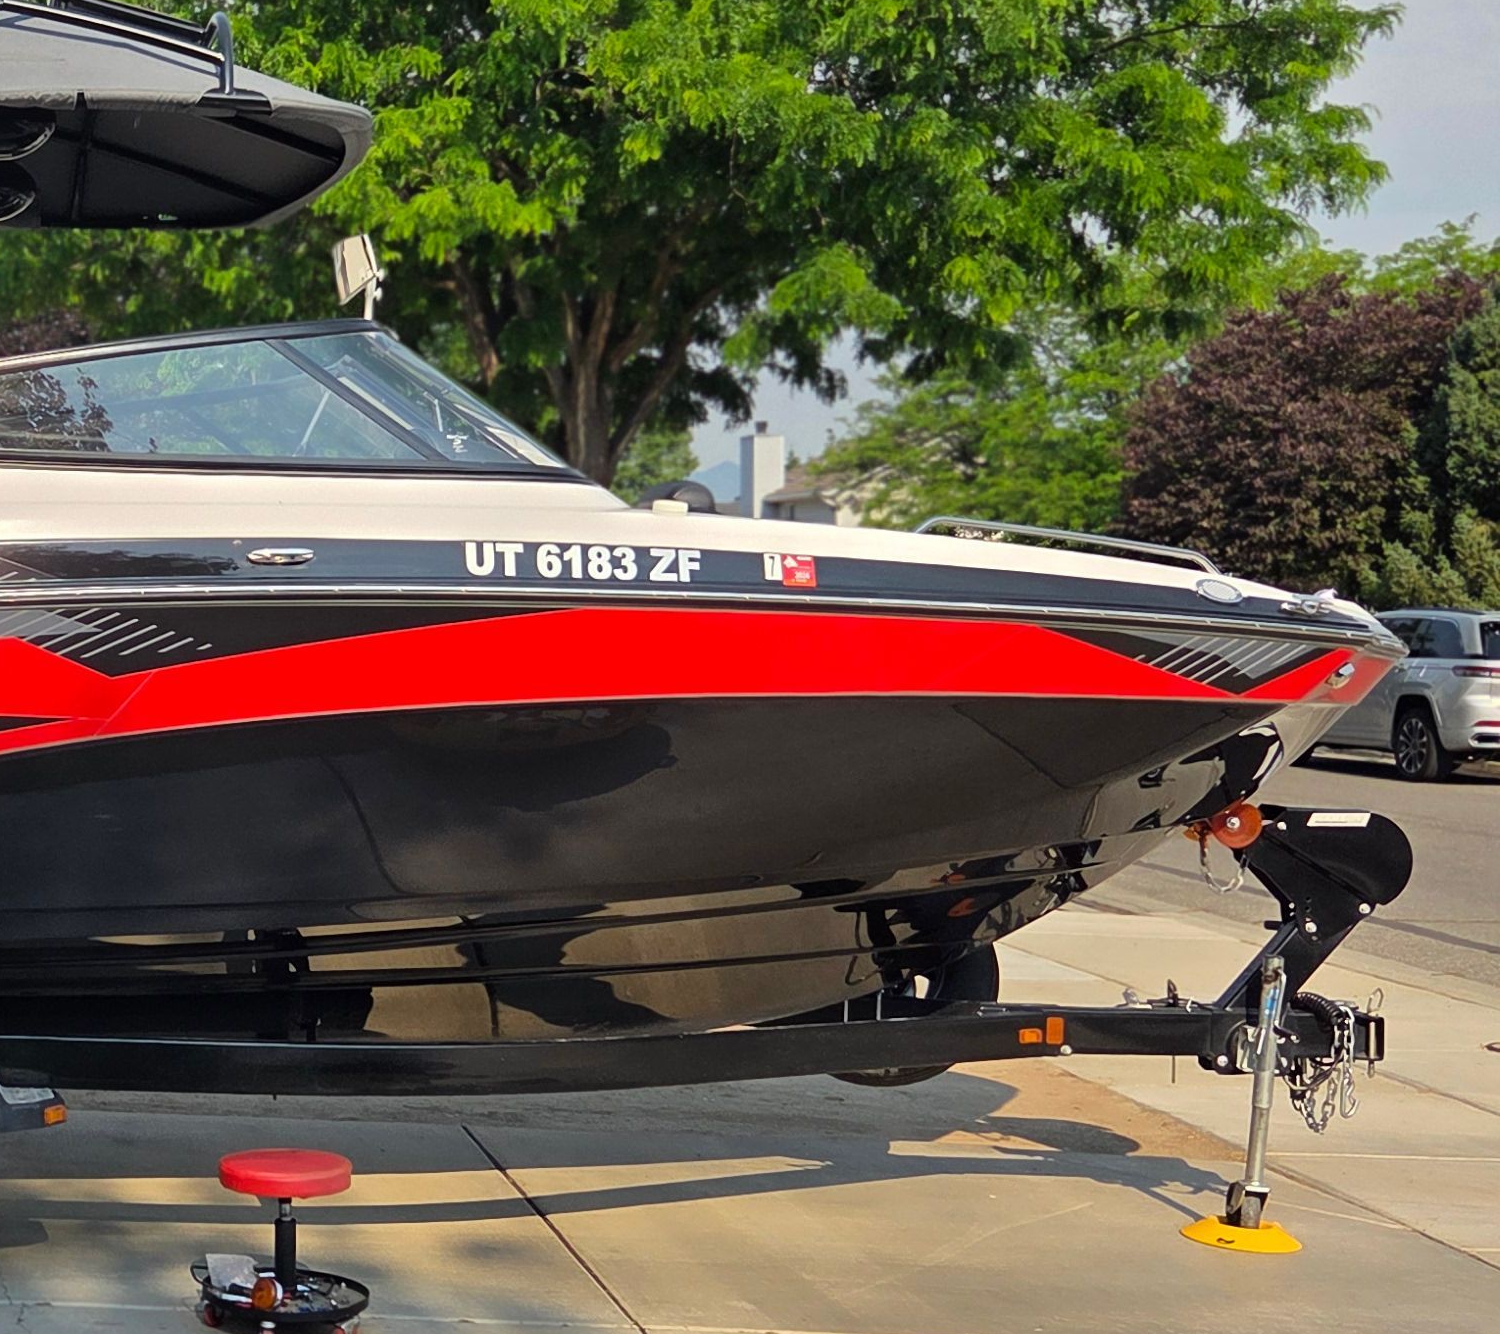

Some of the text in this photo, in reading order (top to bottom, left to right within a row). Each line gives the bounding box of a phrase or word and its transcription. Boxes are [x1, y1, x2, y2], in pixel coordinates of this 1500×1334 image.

[464, 541, 701, 583] UT 6183 ZF
